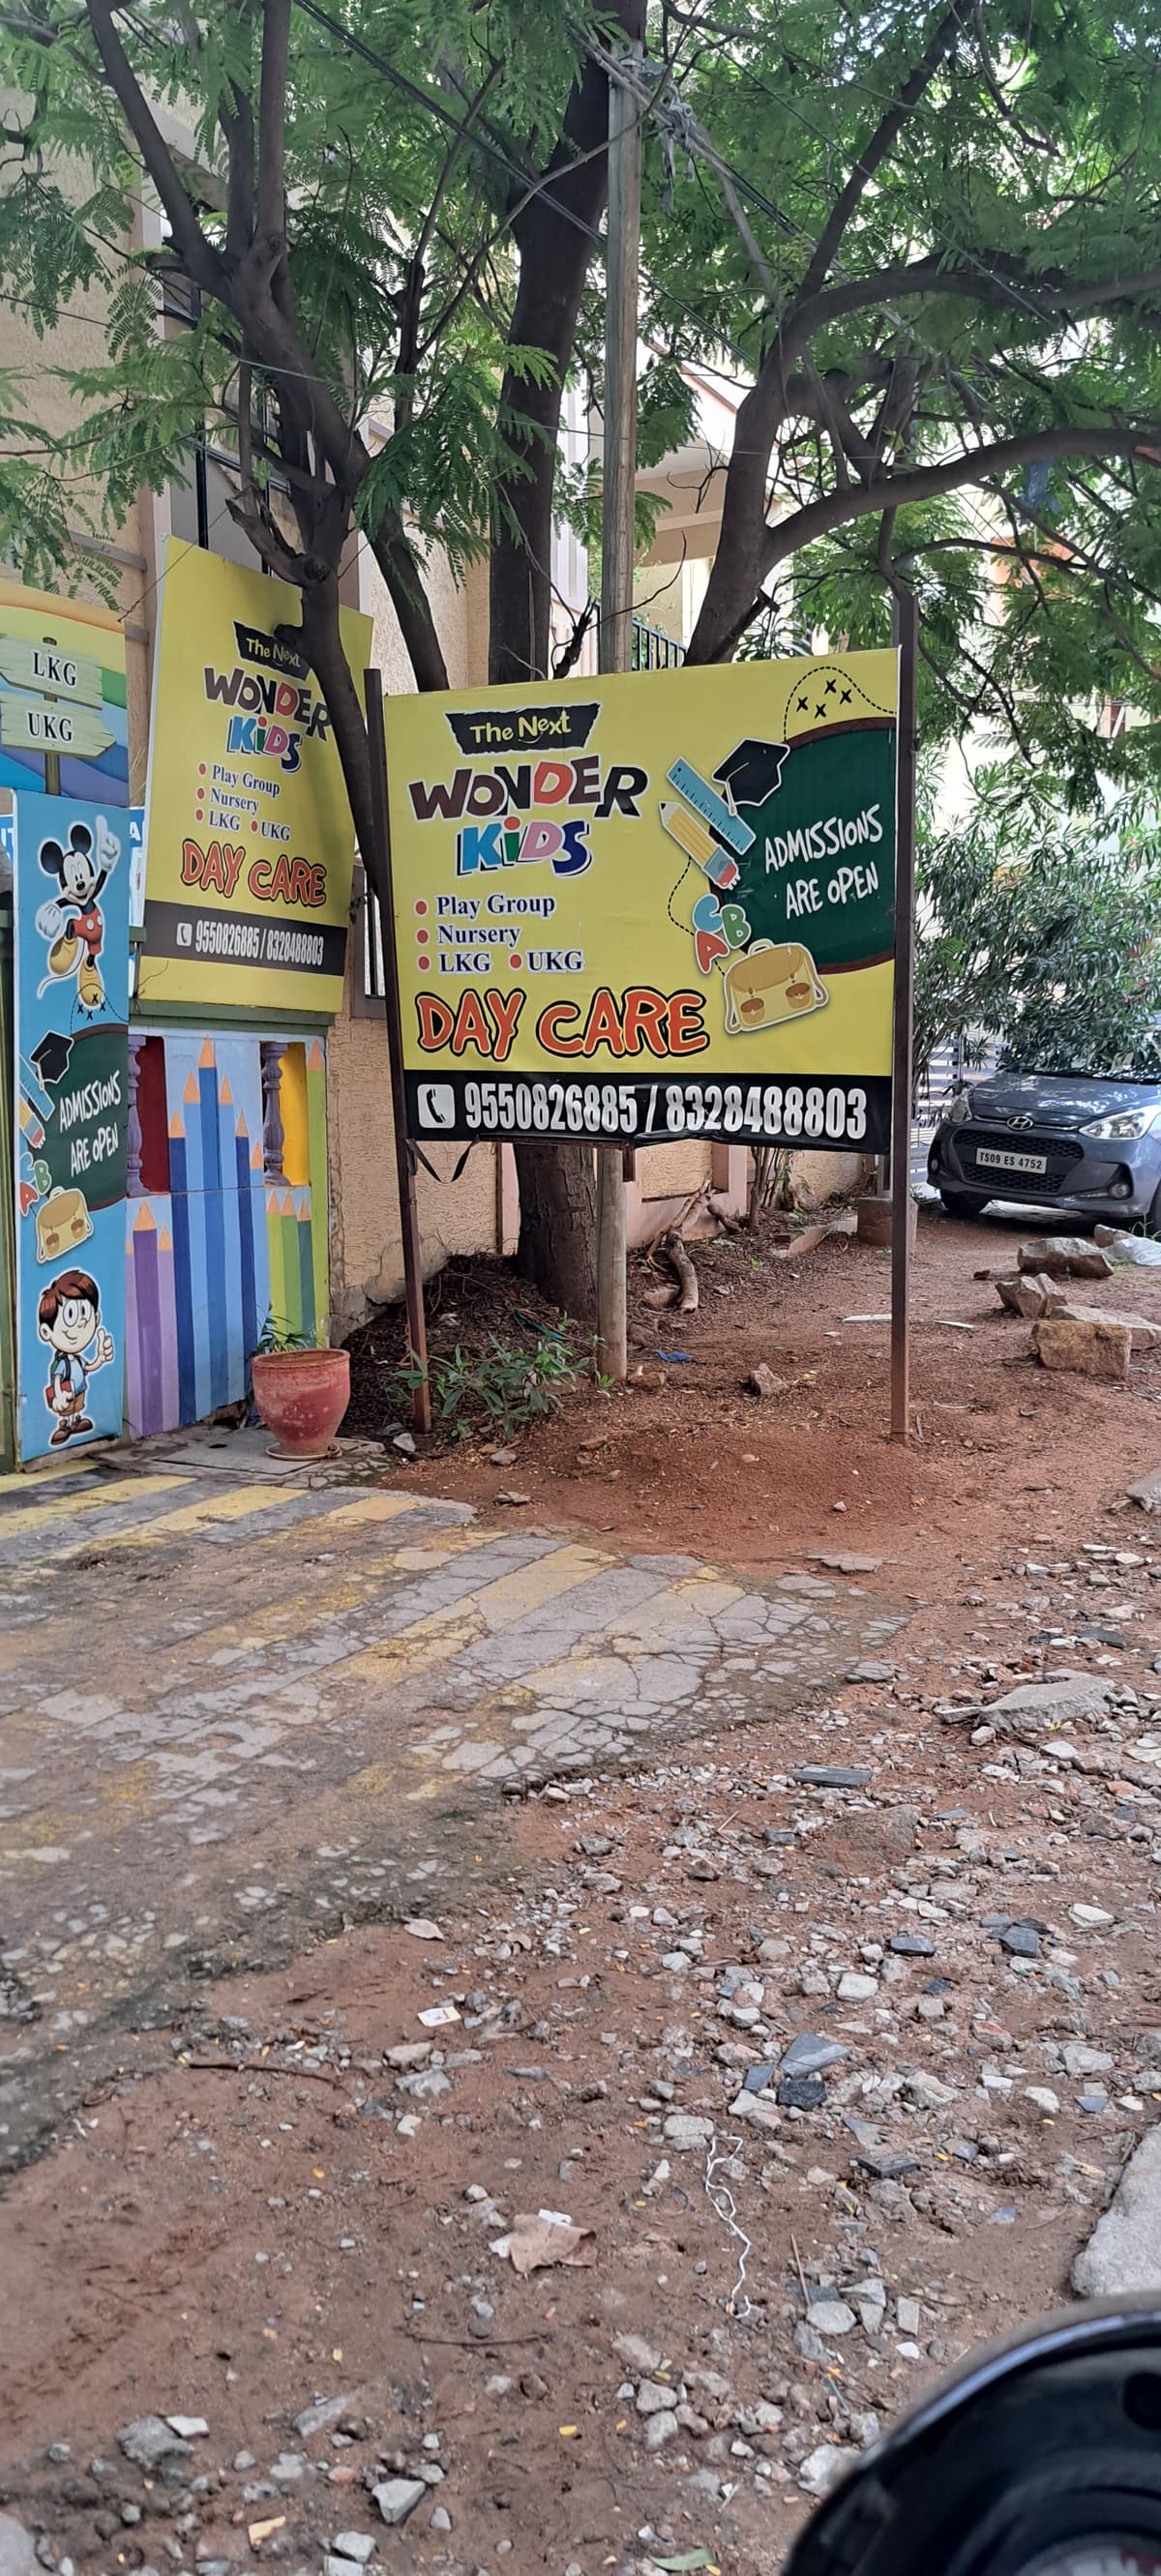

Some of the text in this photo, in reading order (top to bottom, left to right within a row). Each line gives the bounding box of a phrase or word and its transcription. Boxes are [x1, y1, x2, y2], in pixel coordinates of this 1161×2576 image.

[32, 650, 78, 688] LKG
[246, 637, 302, 667] The Next
[203, 666, 332, 742] WONDER
[27, 712, 74, 743] UKG
[469, 709, 573, 744] The Next
[211, 764, 281, 798] Play Group
[408, 755, 648, 820] WONDER
[210, 788, 260, 815] Nursery
[208, 811, 291, 843] LKG UKG
[763, 804, 884, 873] ADMISSIONS
[180, 838, 328, 907] DAY CARE
[436, 894, 556, 919] Play Group
[785, 880, 824, 920] ARE
[194, 918, 260, 958] 9550826885
[266, 927, 324, 966] 8328488803
[437, 926, 521, 947] Nursery
[438, 950, 584, 973] LKG UKG
[415, 987, 711, 1061] DAY CARE
[59, 1069, 122, 1134] ADMISSIONS
[464, 1082, 867, 1140] 9550826885 / 8328488803
[71, 1138, 91, 1178] ARE
[980, 1152, 1042, 1170] TS09 ES 4752
